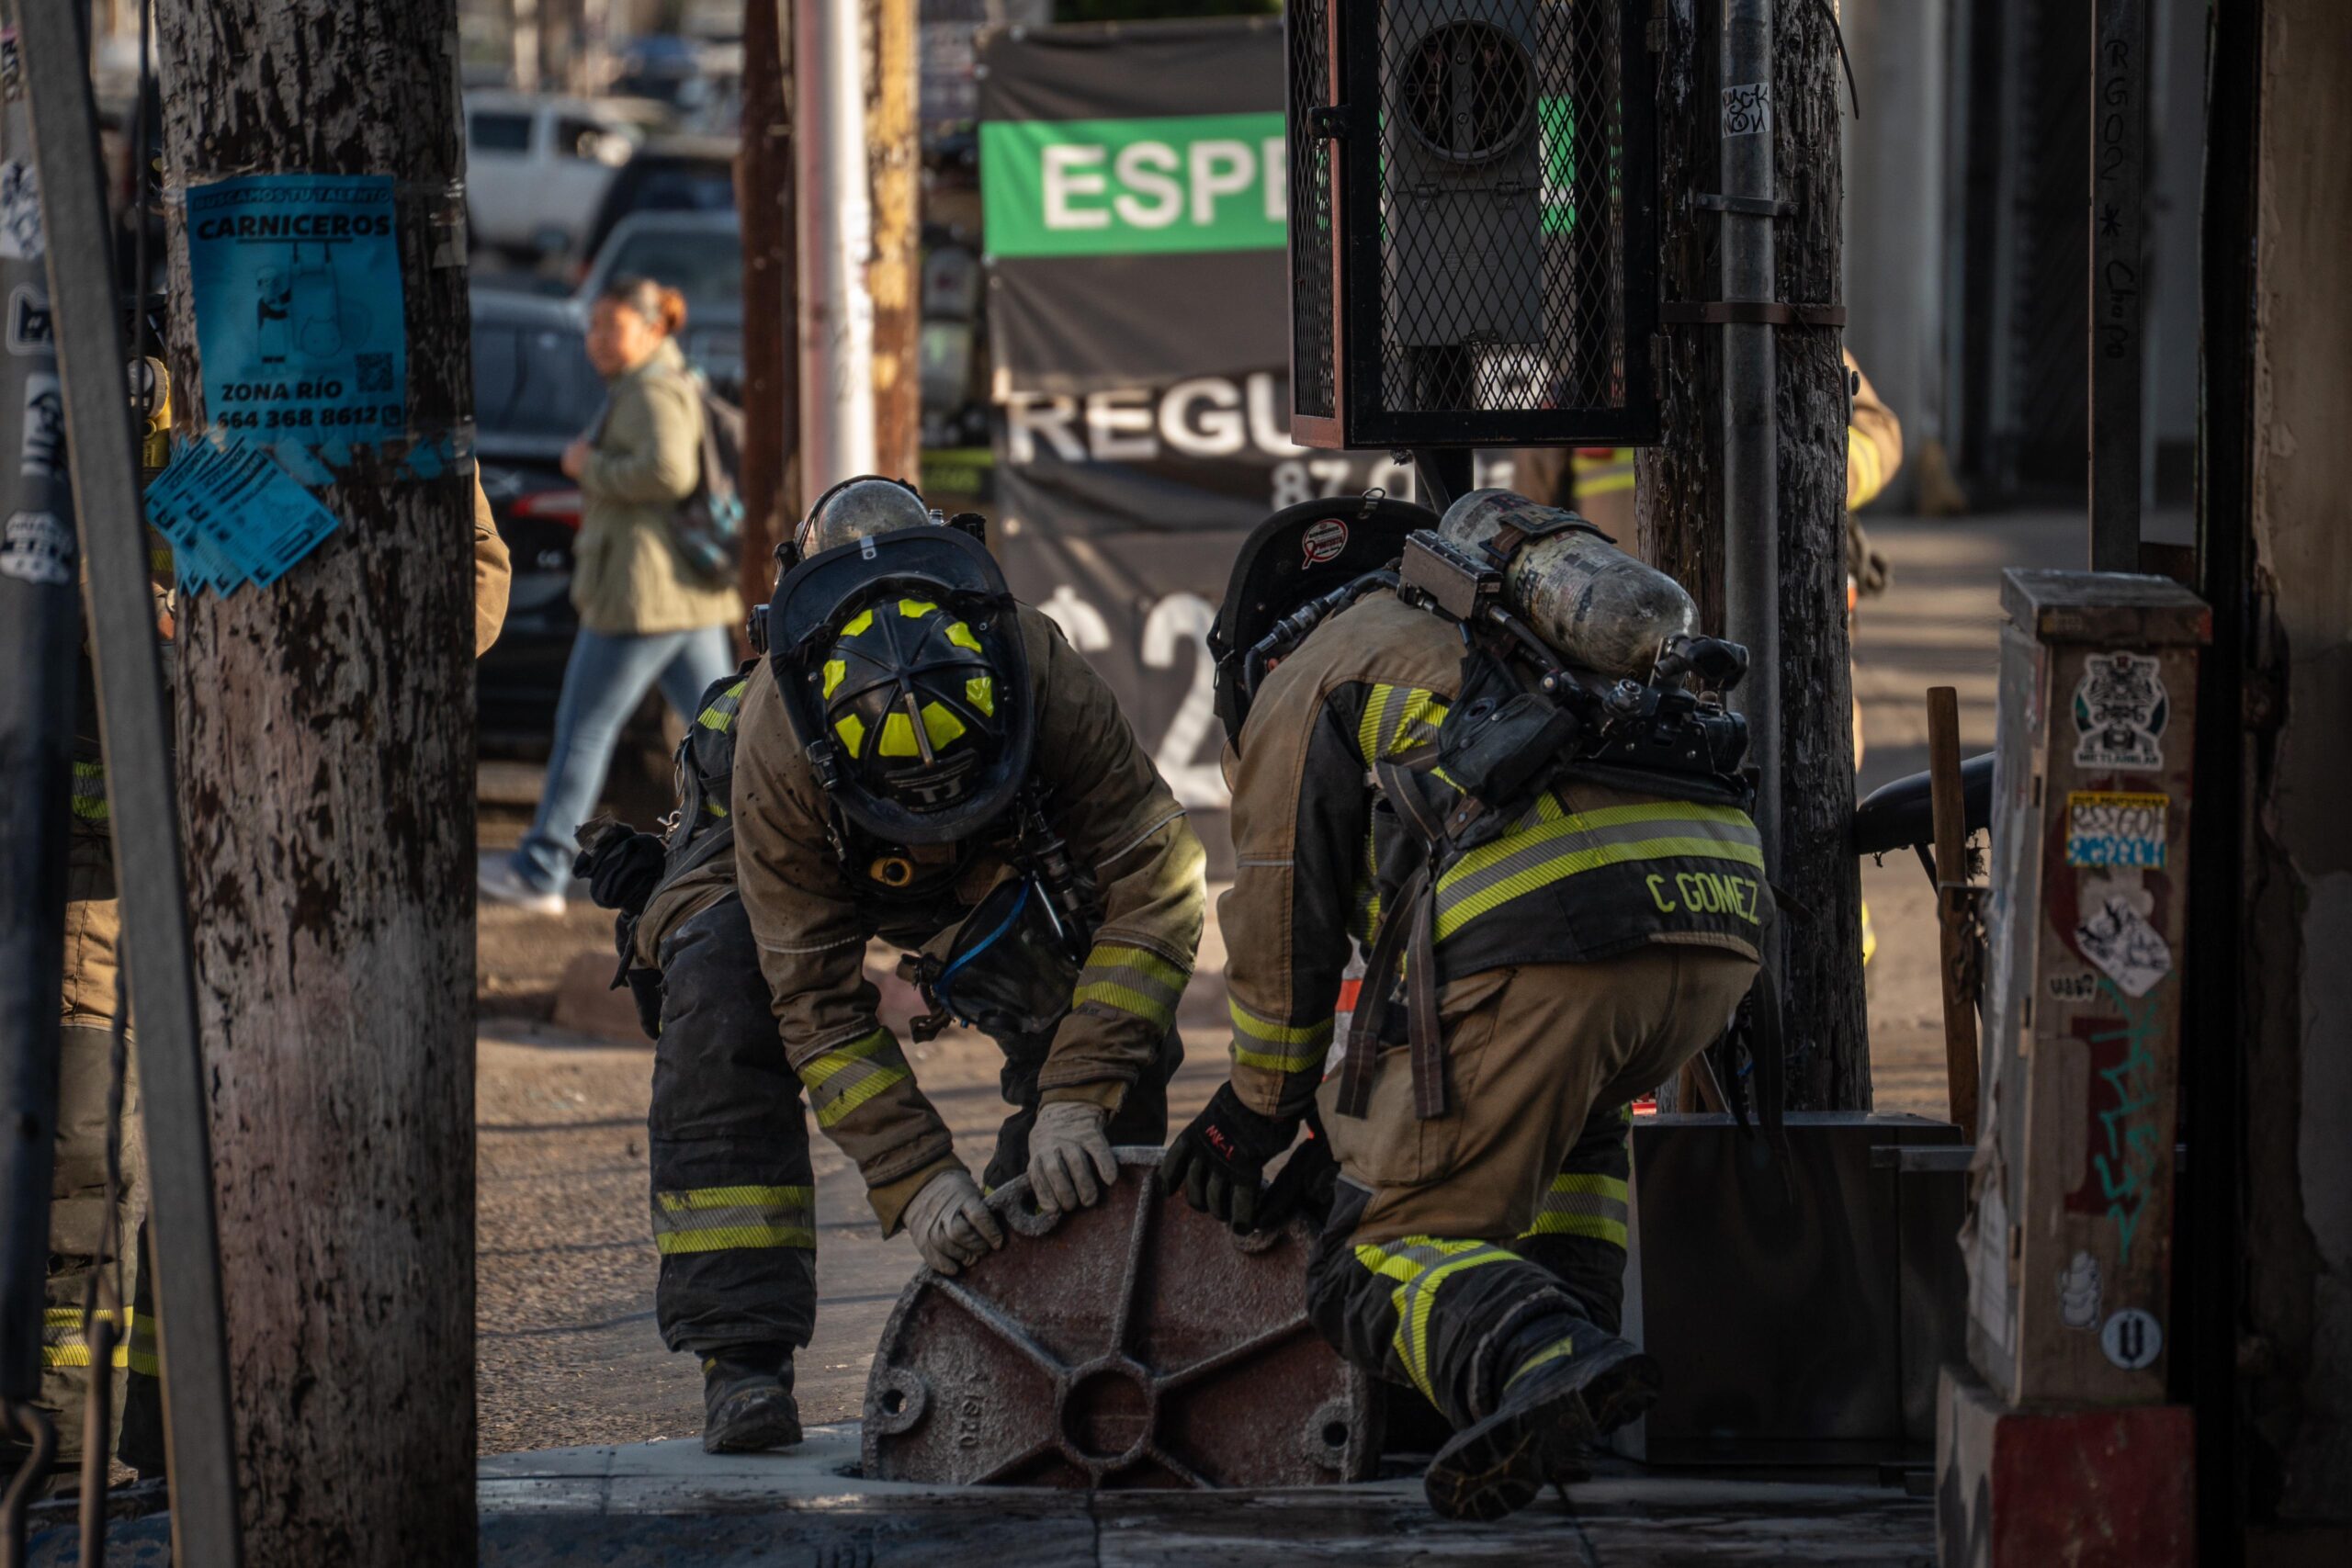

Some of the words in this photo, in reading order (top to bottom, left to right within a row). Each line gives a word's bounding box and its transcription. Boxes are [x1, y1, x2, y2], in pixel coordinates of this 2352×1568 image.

[288, 188, 312, 202] TU
[1040, 139, 1286, 231] ESP
[198, 214, 391, 241] CARNICEROS
[220, 382, 289, 402] ZONA
[296, 374, 343, 400] RÍO
[217, 411, 259, 430] 664
[265, 408, 313, 429] 368
[1007, 372, 1315, 464] REGU
[1645, 873, 1676, 912] C
[1677, 873, 1759, 925] GOMEZ
